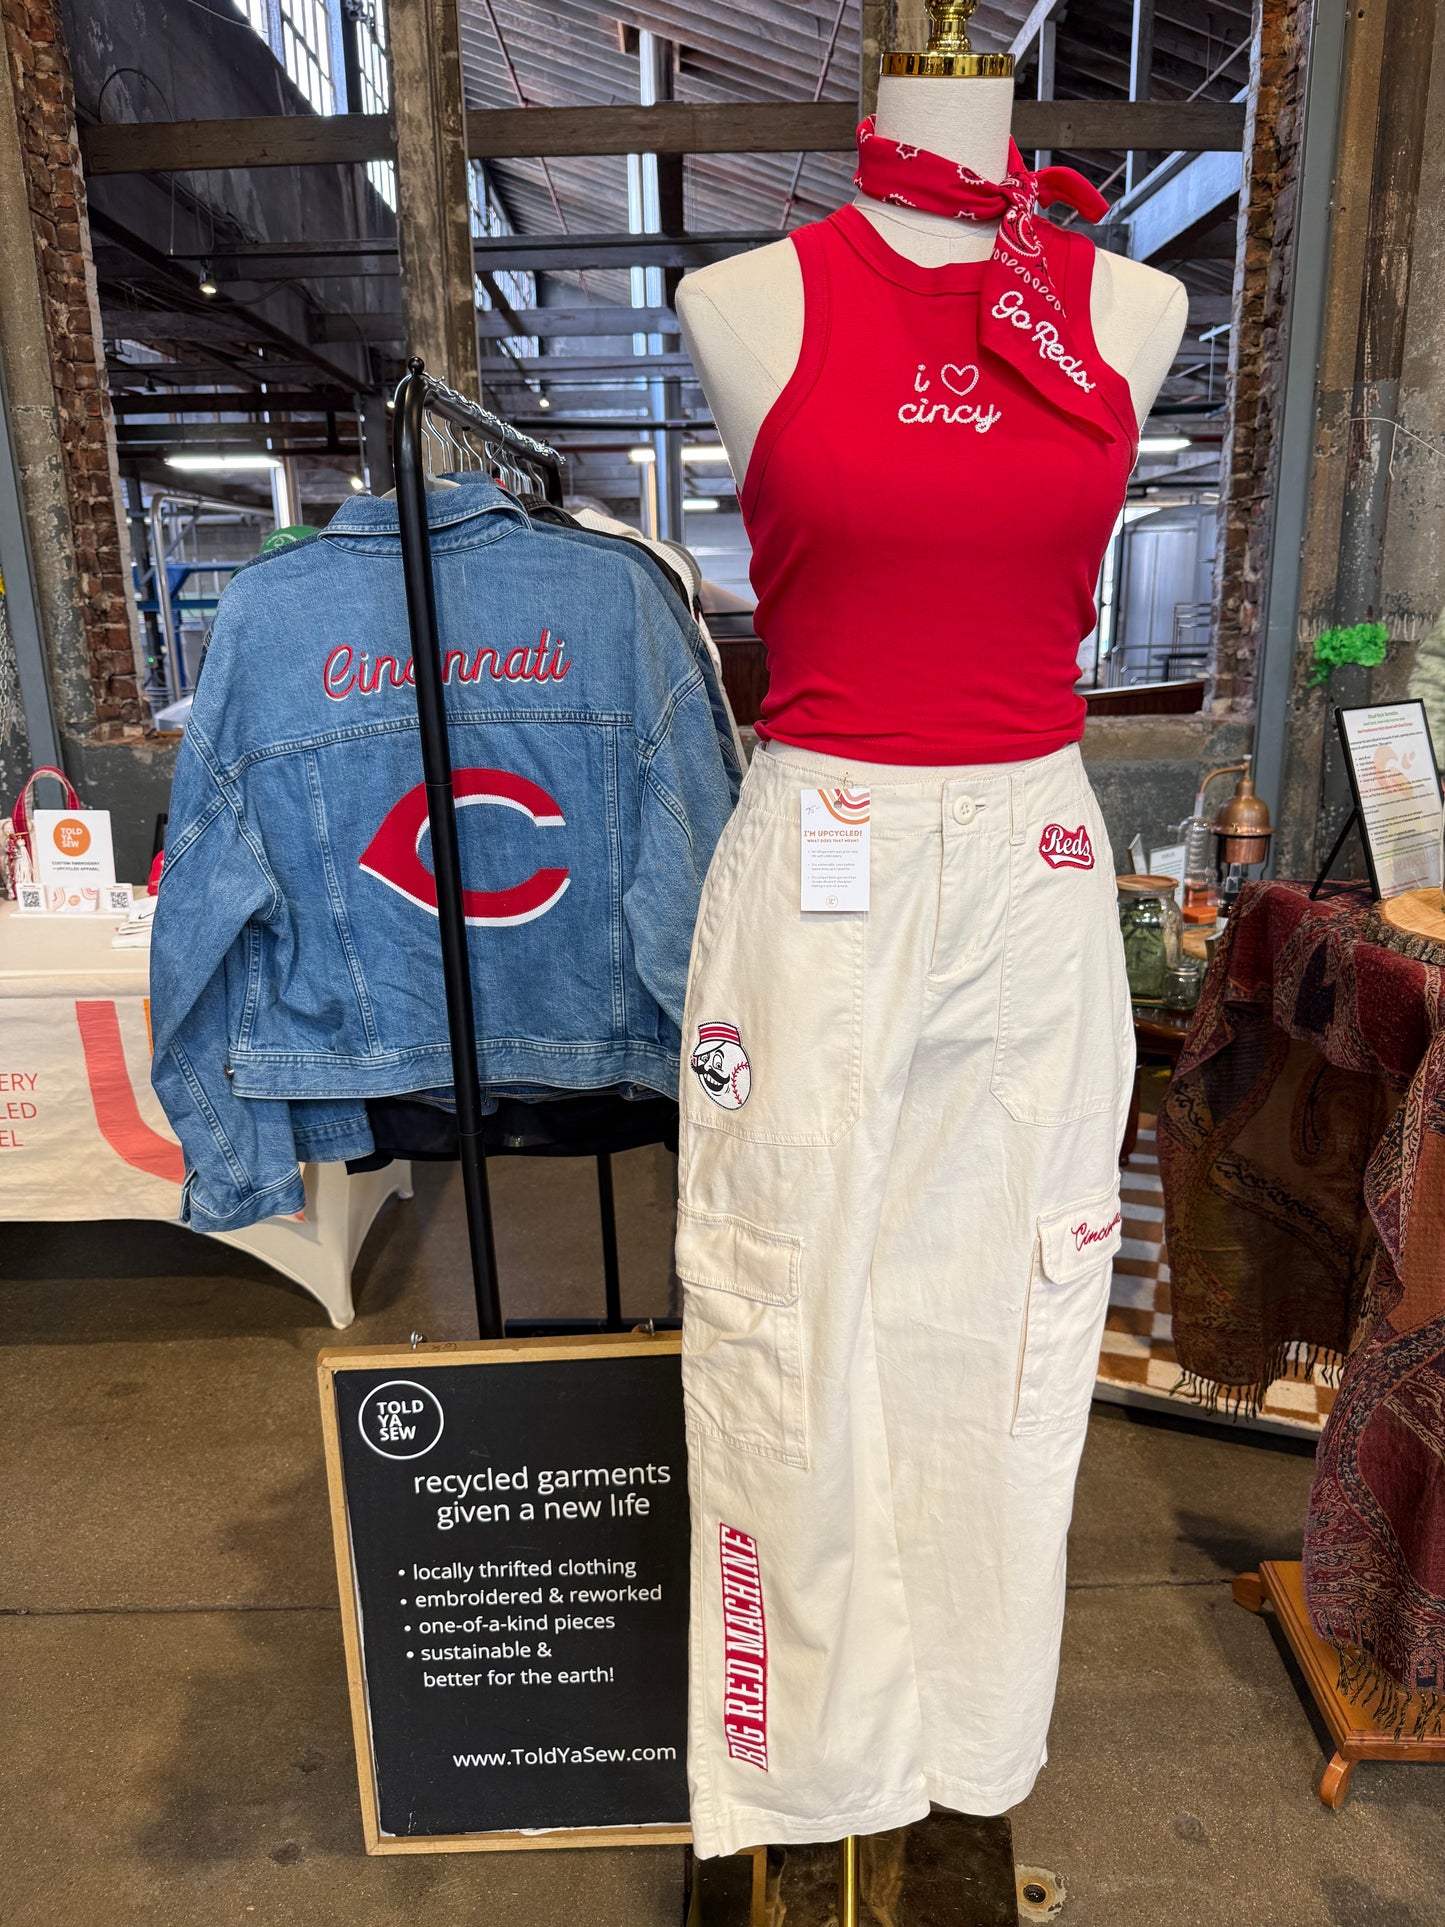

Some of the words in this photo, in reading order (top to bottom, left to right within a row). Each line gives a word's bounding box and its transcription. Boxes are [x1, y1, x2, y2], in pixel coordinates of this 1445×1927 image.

[991, 290, 1033, 330] Go
[1031, 320, 1096, 393] Reds
[914, 364, 931, 393] i
[897, 397, 1002, 434] cincy
[323, 628, 571, 702] Cincnnati
[60, 827, 83, 836] TOLD
[61, 834, 73, 842] YA
[1041, 825, 1092, 862] Reds
[61, 840, 80, 848] SEW
[377, 1400, 424, 1415] TOLD
[378, 1415, 402, 1428] YA
[380, 1426, 417, 1441] SEW
[414, 1466, 529, 1499] recycled
[537, 1463, 671, 1496] garments
[437, 1500, 510, 1531] given
[519, 1502, 535, 1521] a
[544, 1501, 602, 1520] new
[610, 1492, 650, 1517] life
[413, 1562, 474, 1583] locally
[478, 1559, 552, 1578] thrifted
[558, 1558, 637, 1579] clothing
[415, 1587, 543, 1608] embroidered
[548, 1587, 564, 1604] &
[569, 1584, 662, 1603] reworked
[721, 1527, 764, 1659] MACHINE
[418, 1614, 548, 1635] one-of-a-kind
[554, 1613, 616, 1635] pieces
[420, 1641, 532, 1661] sustainable
[536, 1641, 553, 1658] &
[423, 1672, 483, 1688] better
[486, 1669, 516, 1686] for
[519, 1669, 552, 1685] the
[557, 1666, 614, 1684] earth!
[726, 1657, 764, 1722] RED
[452, 1746, 678, 1768] www.ToldYaSew.com
[726, 1723, 767, 1769] BIG
